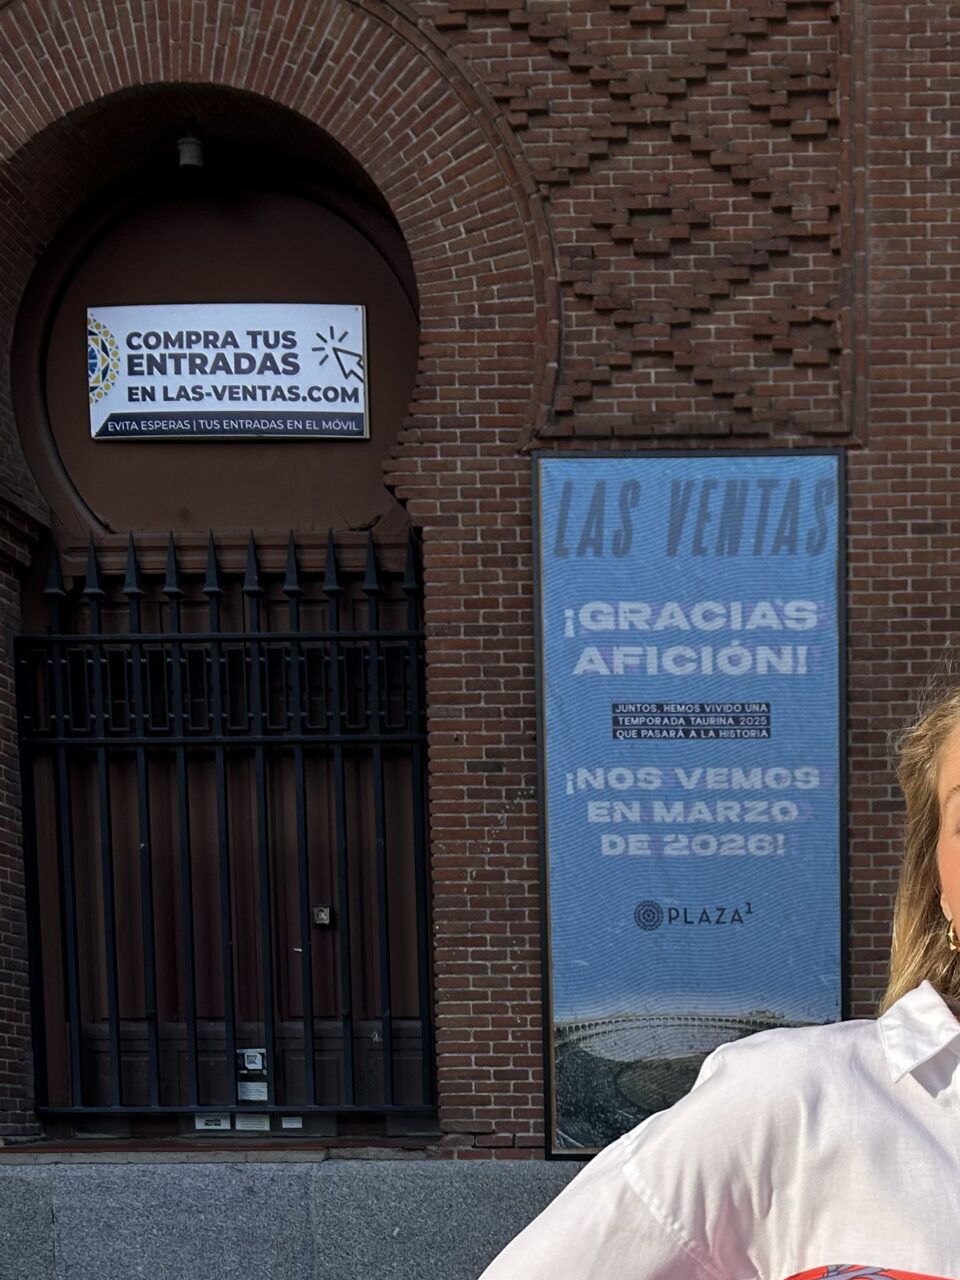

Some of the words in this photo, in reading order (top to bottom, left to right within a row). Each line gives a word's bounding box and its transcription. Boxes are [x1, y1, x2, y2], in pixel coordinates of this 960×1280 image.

[126, 330, 239, 350] COMPRA
[246, 330, 298, 350] TUS
[127, 352, 300, 376] ENTRADAS
[127, 386, 156, 402] EN
[163, 385, 360, 403] LAS-VENTAS.COM
[108, 421, 139, 432] EVITA
[141, 420, 191, 431] ESPERAS
[199, 419, 220, 430] TUS
[223, 419, 285, 430] ENTRADAS
[287, 420, 303, 430] EN
[305, 419, 319, 430] EL
[322, 418, 360, 431] MÓVIL
[553, 478, 642, 559] LAS
[666, 477, 837, 558] VENTAS
[563, 600, 818, 638] ¡GRACIAS
[572, 640, 808, 675] AFICIÓN!
[615, 704, 661, 714] JUNTOS,
[663, 704, 701, 713] HEMOS
[704, 703, 742, 713] VIVIDO
[745, 703, 768, 713] UNA
[618, 716, 686, 726] TEMPORADA
[690, 716, 735, 726] TAURINA
[739, 716, 768, 726] 2025
[616, 729, 638, 740] QUE
[641, 727, 685, 739] PASARÁ
[689, 729, 698, 739] A
[701, 729, 715, 739] LA
[719, 729, 769, 739] HISTORIA
[566, 767, 662, 795] ¡NOS
[674, 767, 821, 790] VEMOS
[587, 800, 640, 823] EN
[653, 800, 800, 823] MARZO
[601, 834, 651, 856] DE
[663, 833, 786, 857] 2026!
